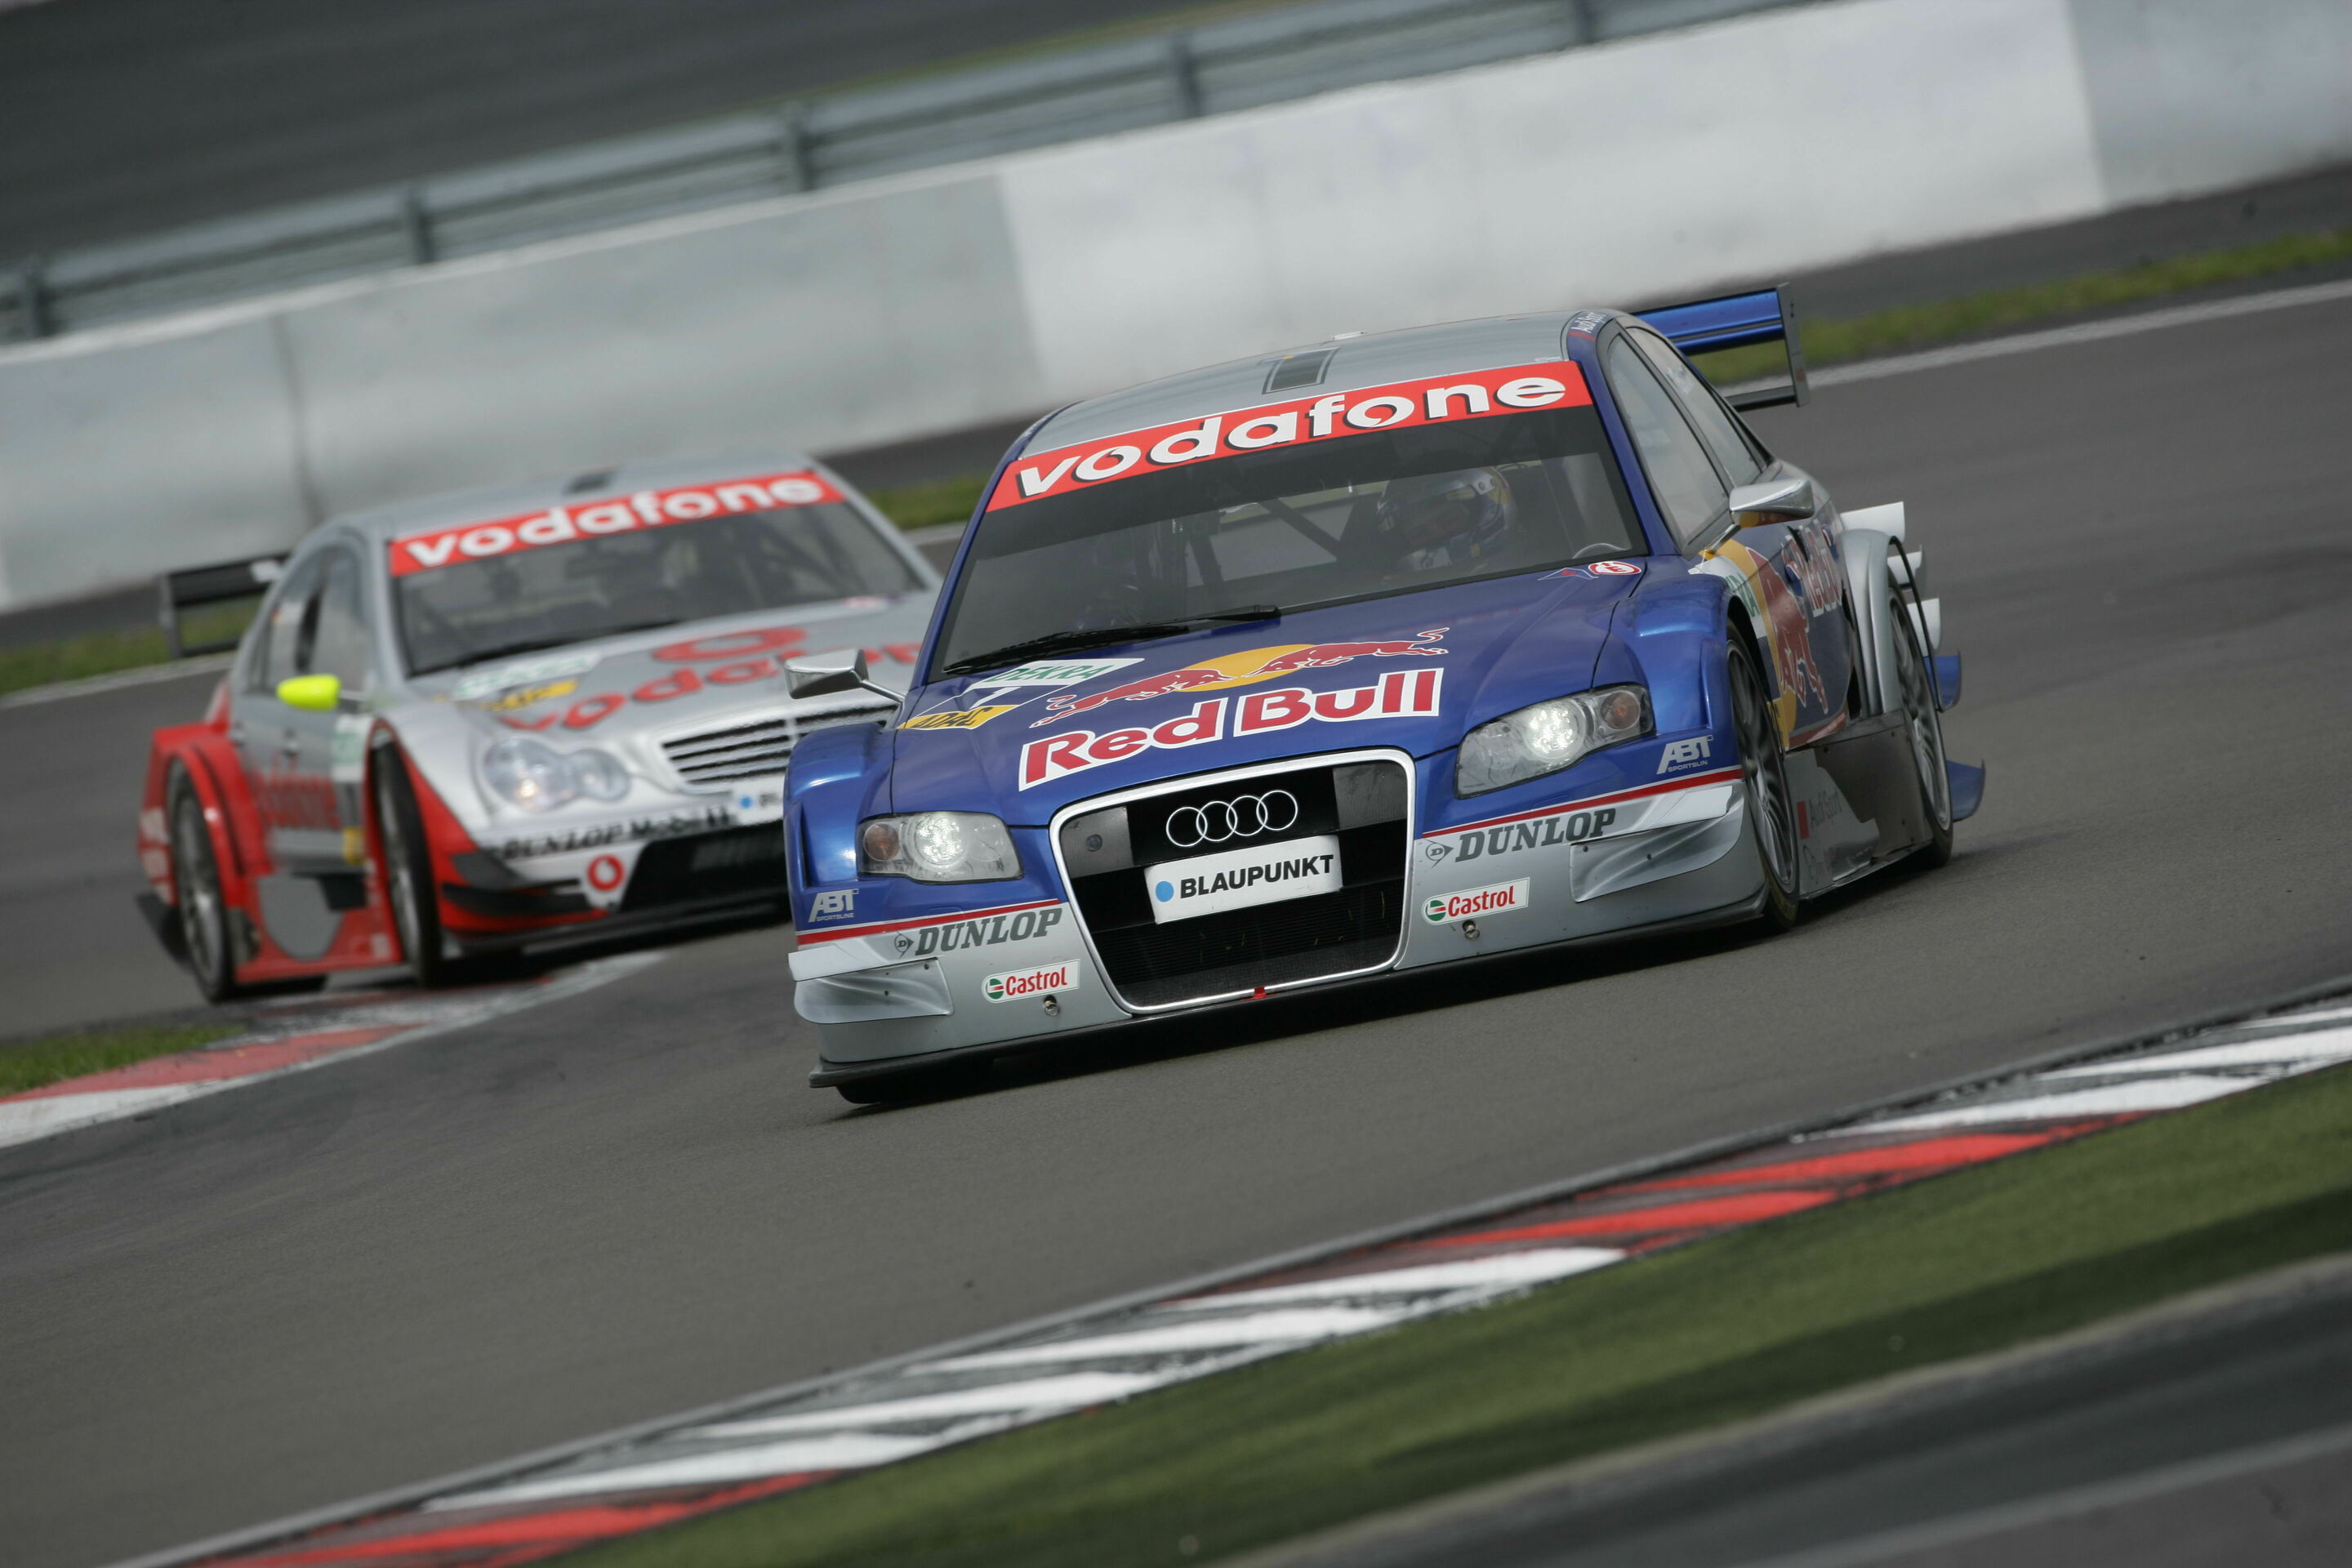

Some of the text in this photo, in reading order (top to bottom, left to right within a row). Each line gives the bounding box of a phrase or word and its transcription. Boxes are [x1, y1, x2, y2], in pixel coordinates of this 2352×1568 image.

[1019, 376, 1566, 499] vodafone
[405, 475, 823, 568] vodafone
[982, 664, 1116, 684] DEKRA
[1019, 667, 1444, 791] Red Bull
[1656, 735, 1712, 775] ABT
[1455, 808, 1617, 863] DUNLOP
[1180, 854, 1334, 899] BLAUPUNKT
[808, 889, 855, 923] ABT
[1448, 885, 1516, 917] Castrol
[915, 907, 1062, 956] DUNLOP
[1005, 966, 1068, 996] Castrol
